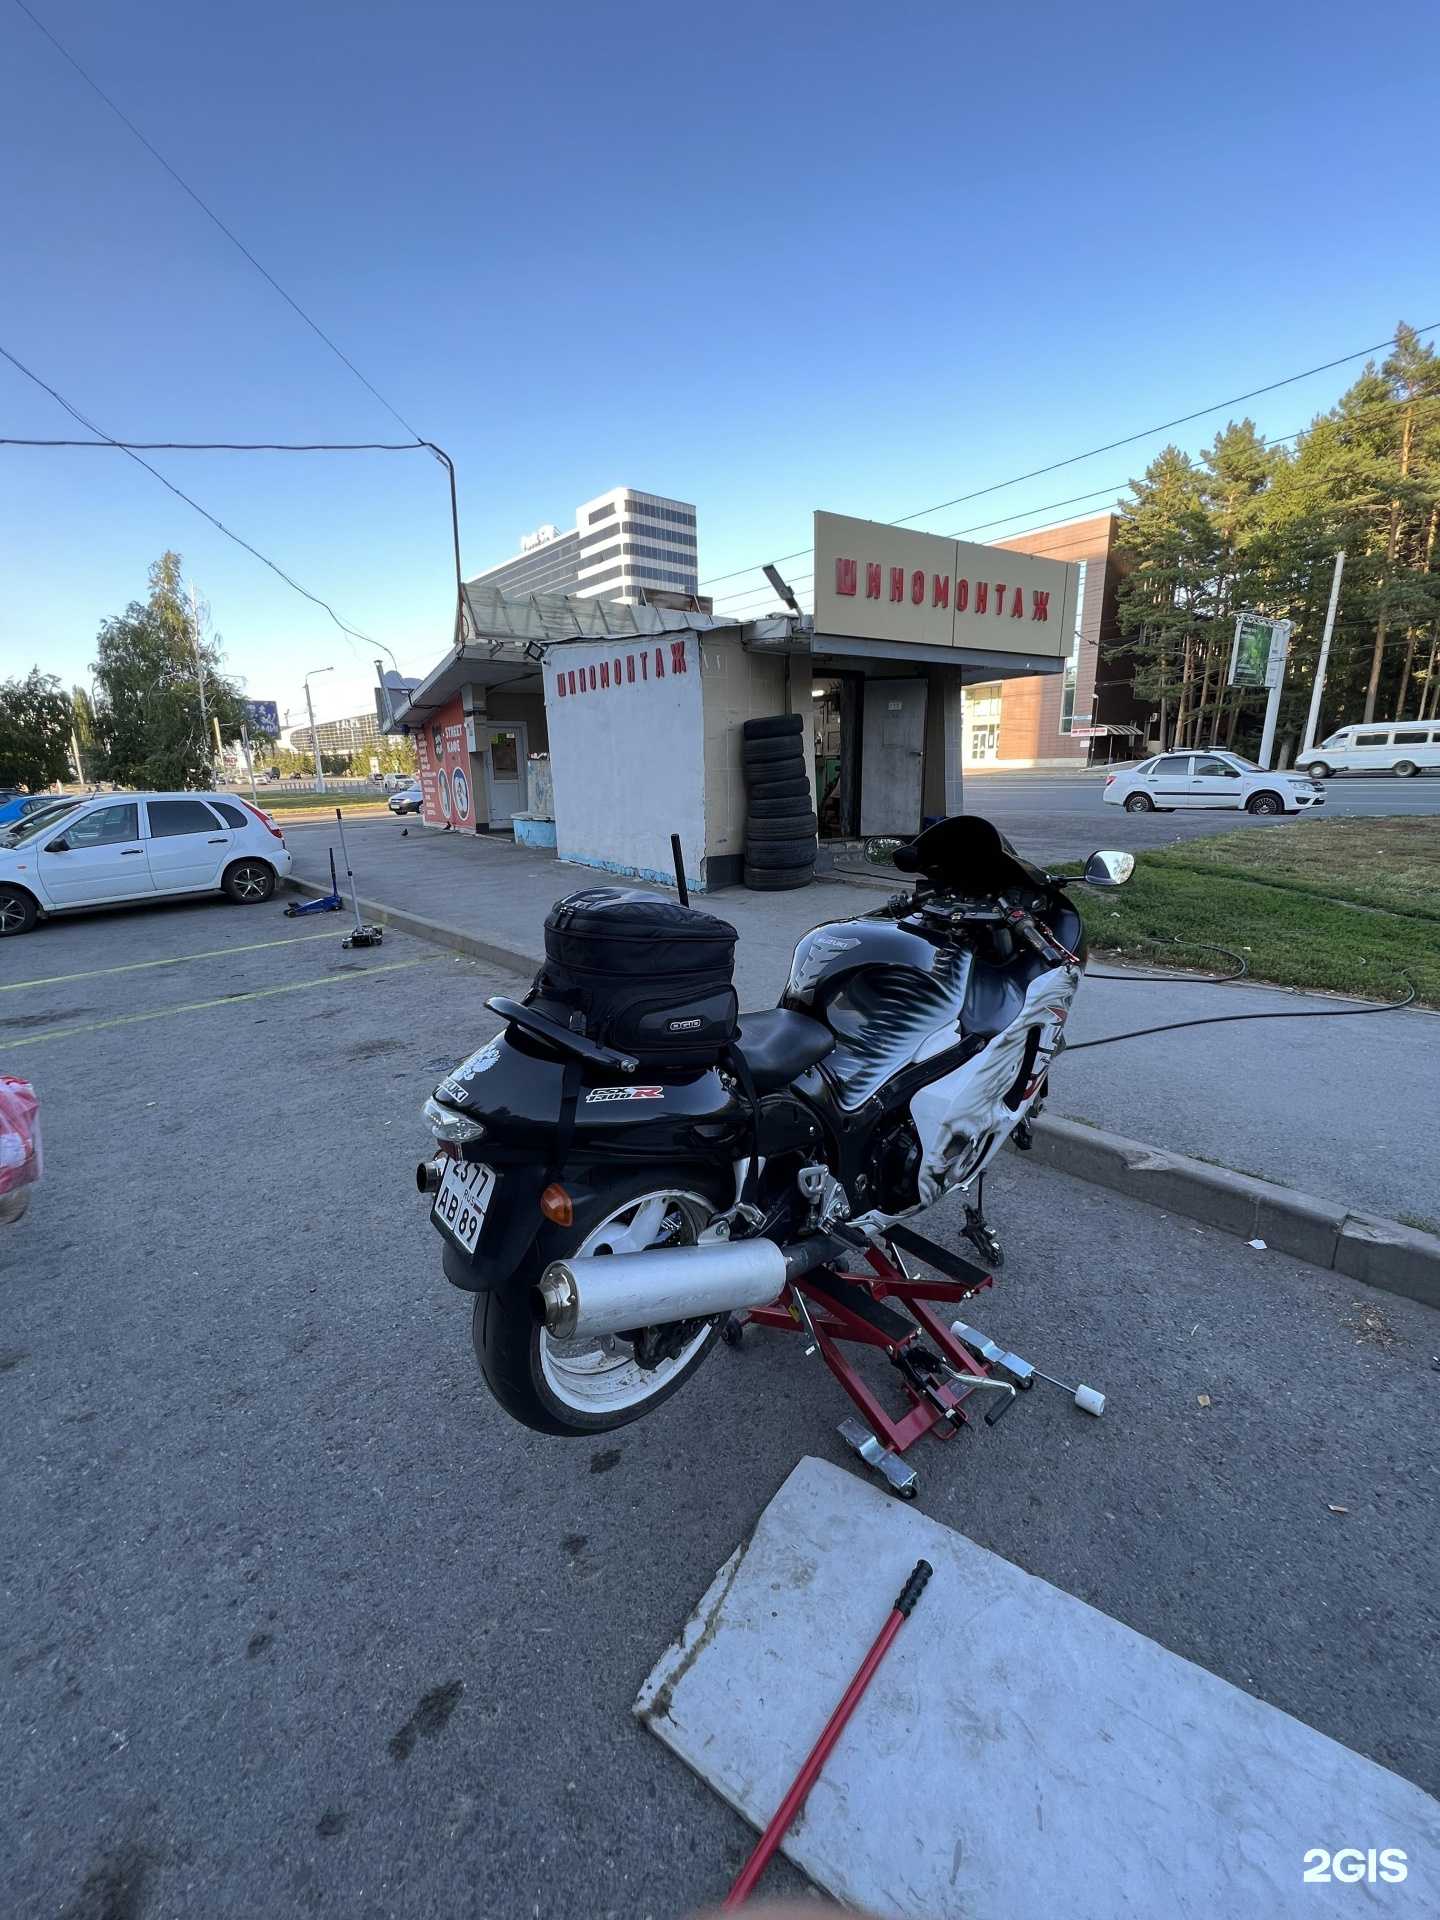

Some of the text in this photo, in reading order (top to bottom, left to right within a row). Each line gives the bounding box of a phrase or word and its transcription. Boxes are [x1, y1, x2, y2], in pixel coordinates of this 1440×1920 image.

[835, 557, 1050, 622] ШИНОМОНТАЖ
[556, 640, 687, 697] ШИНОМОНТАЖ
[445, 724, 463, 738] STREET
[444, 1080, 468, 1101] ZUKI
[438, 1185, 478, 1243] AB 89
[464, 1188, 475, 1207] RUS
